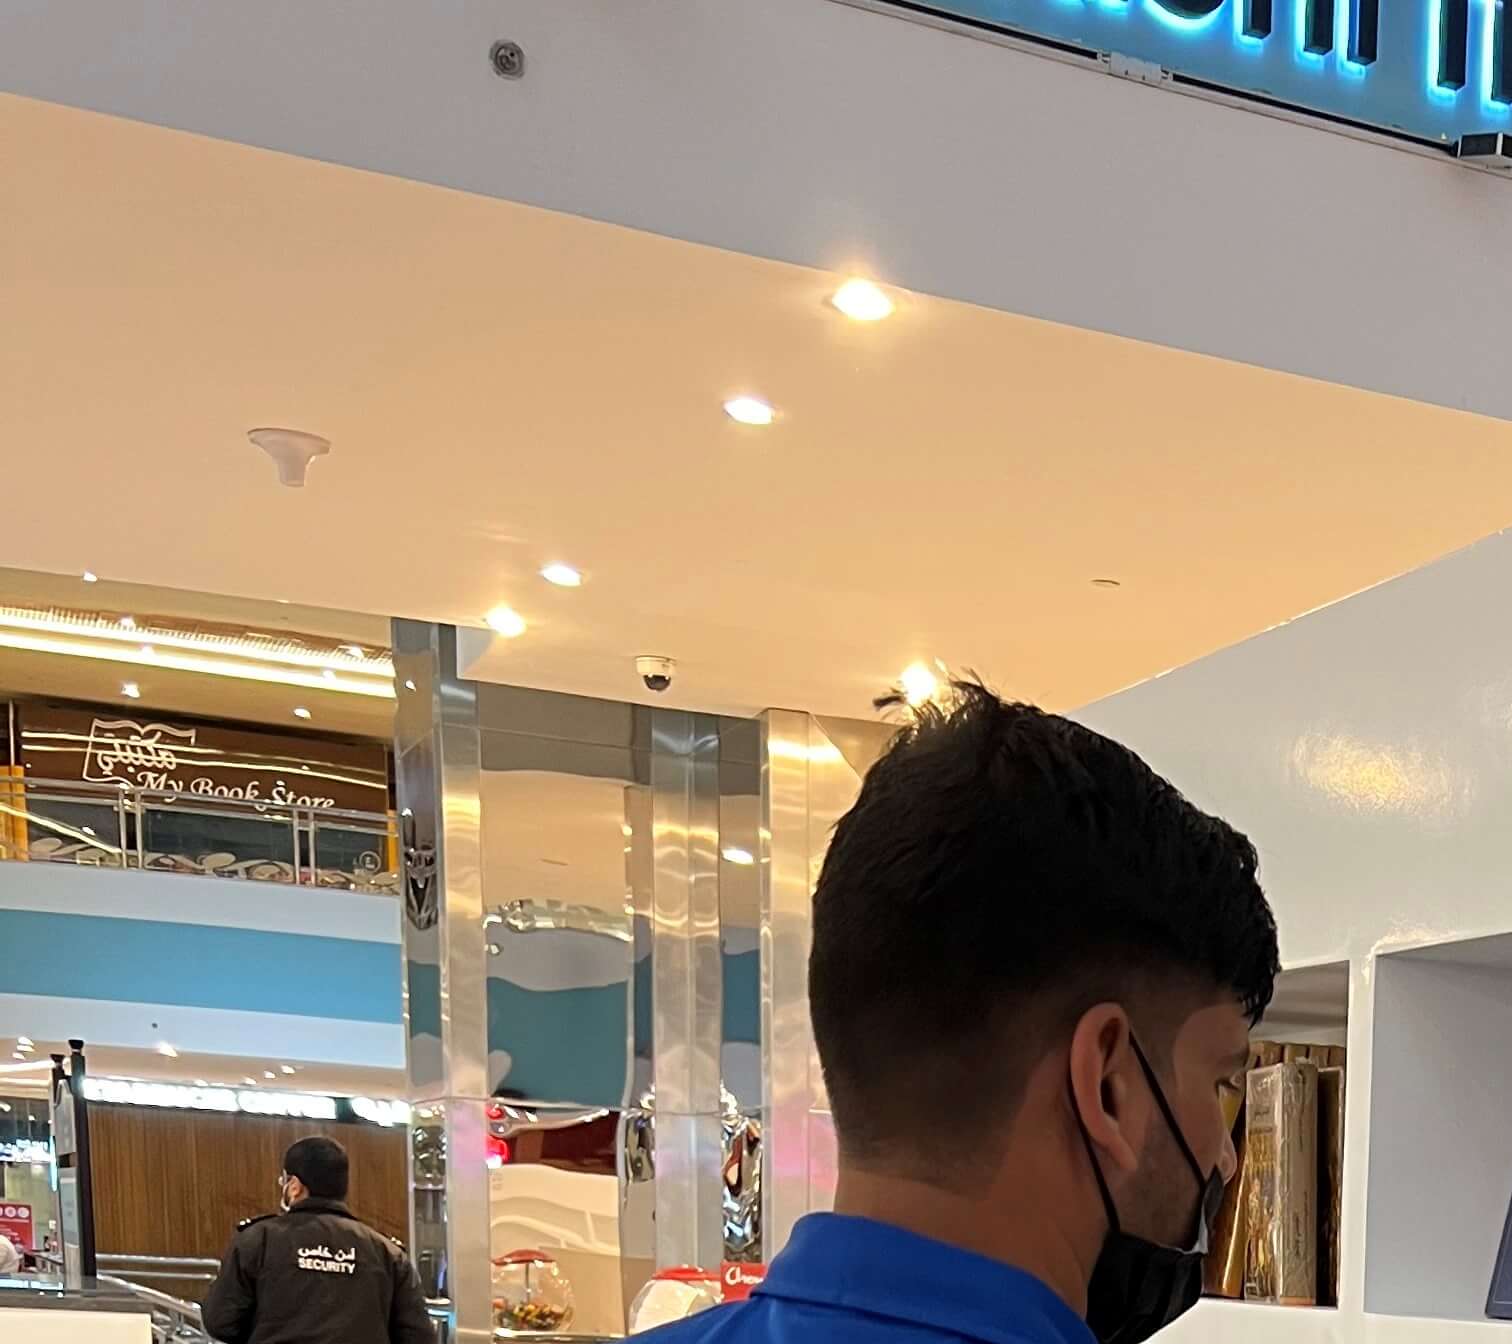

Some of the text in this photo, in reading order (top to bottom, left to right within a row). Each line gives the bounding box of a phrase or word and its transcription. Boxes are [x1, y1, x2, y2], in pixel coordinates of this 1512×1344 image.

[137, 771, 184, 803] My
[190, 778, 262, 812] Book
[298, 1257, 356, 1274] SECURITY
